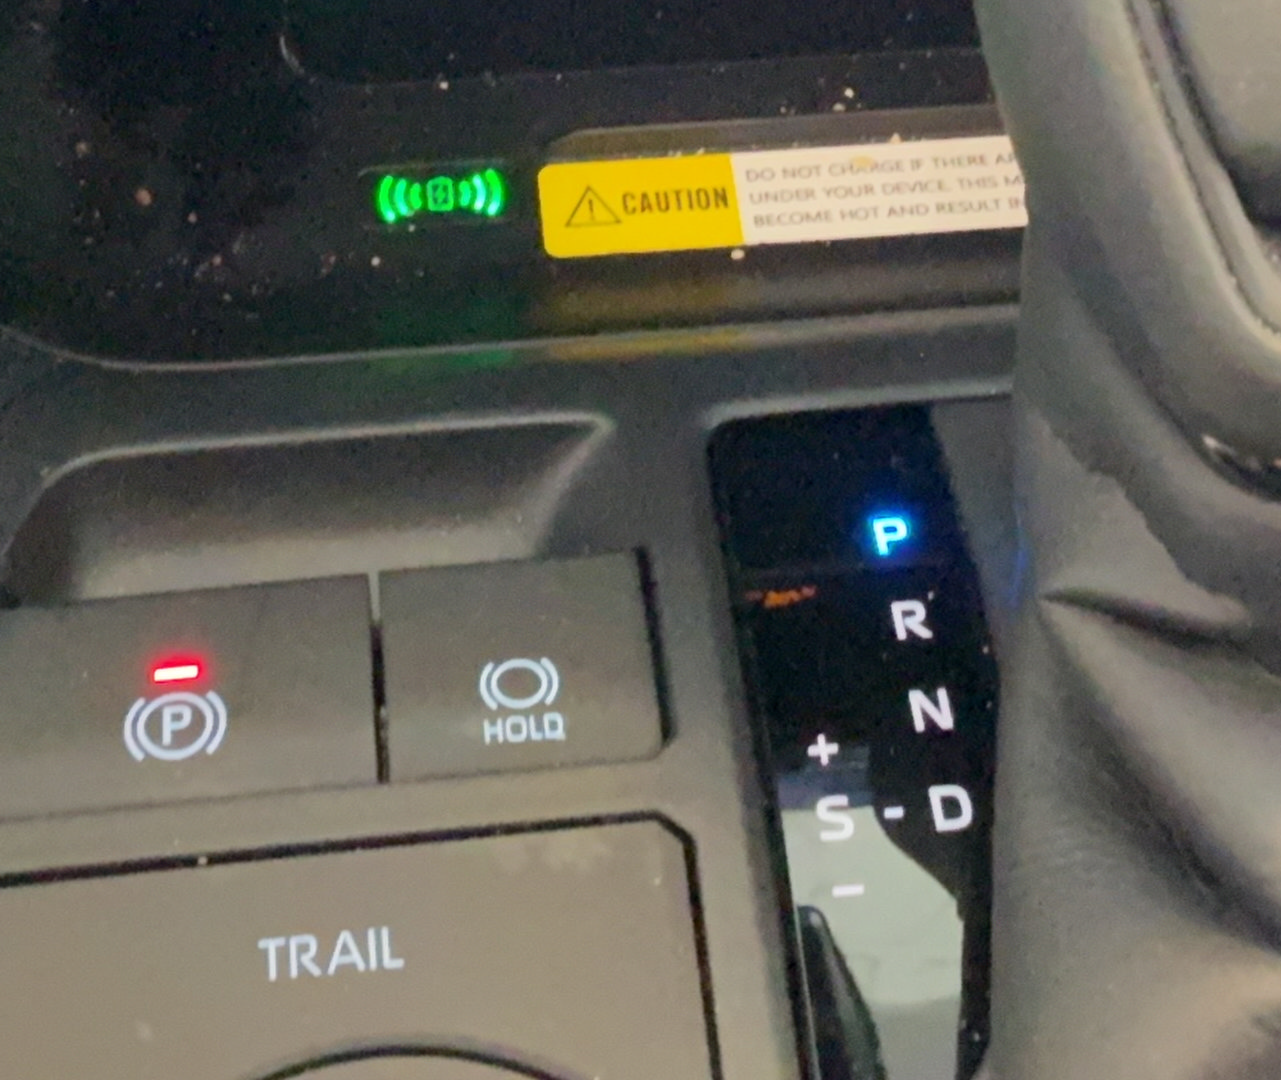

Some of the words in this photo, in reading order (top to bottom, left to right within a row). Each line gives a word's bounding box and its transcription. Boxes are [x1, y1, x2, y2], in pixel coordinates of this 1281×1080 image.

[745, 167, 776, 183] DO
[781, 165, 822, 180] NOT
[828, 159, 904, 177] CHARGE
[932, 153, 988, 169] THERE
[622, 186, 730, 215] CAUTION
[748, 187, 816, 206] UNDER
[821, 183, 875, 201] YOUR
[957, 175, 998, 190] THIS
[753, 209, 834, 229] BECOME
[839, 206, 880, 223] HOT
[887, 202, 930, 219] AND
[935, 198, 1001, 214] RESULT
[870, 513, 910, 557] P
[890, 599, 933, 641] R
[483, 712, 566, 744] HOLD
[907, 687, 955, 733] N
[816, 794, 855, 842] S
[927, 784, 974, 833] D
[257, 926, 405, 982] TRAIL
